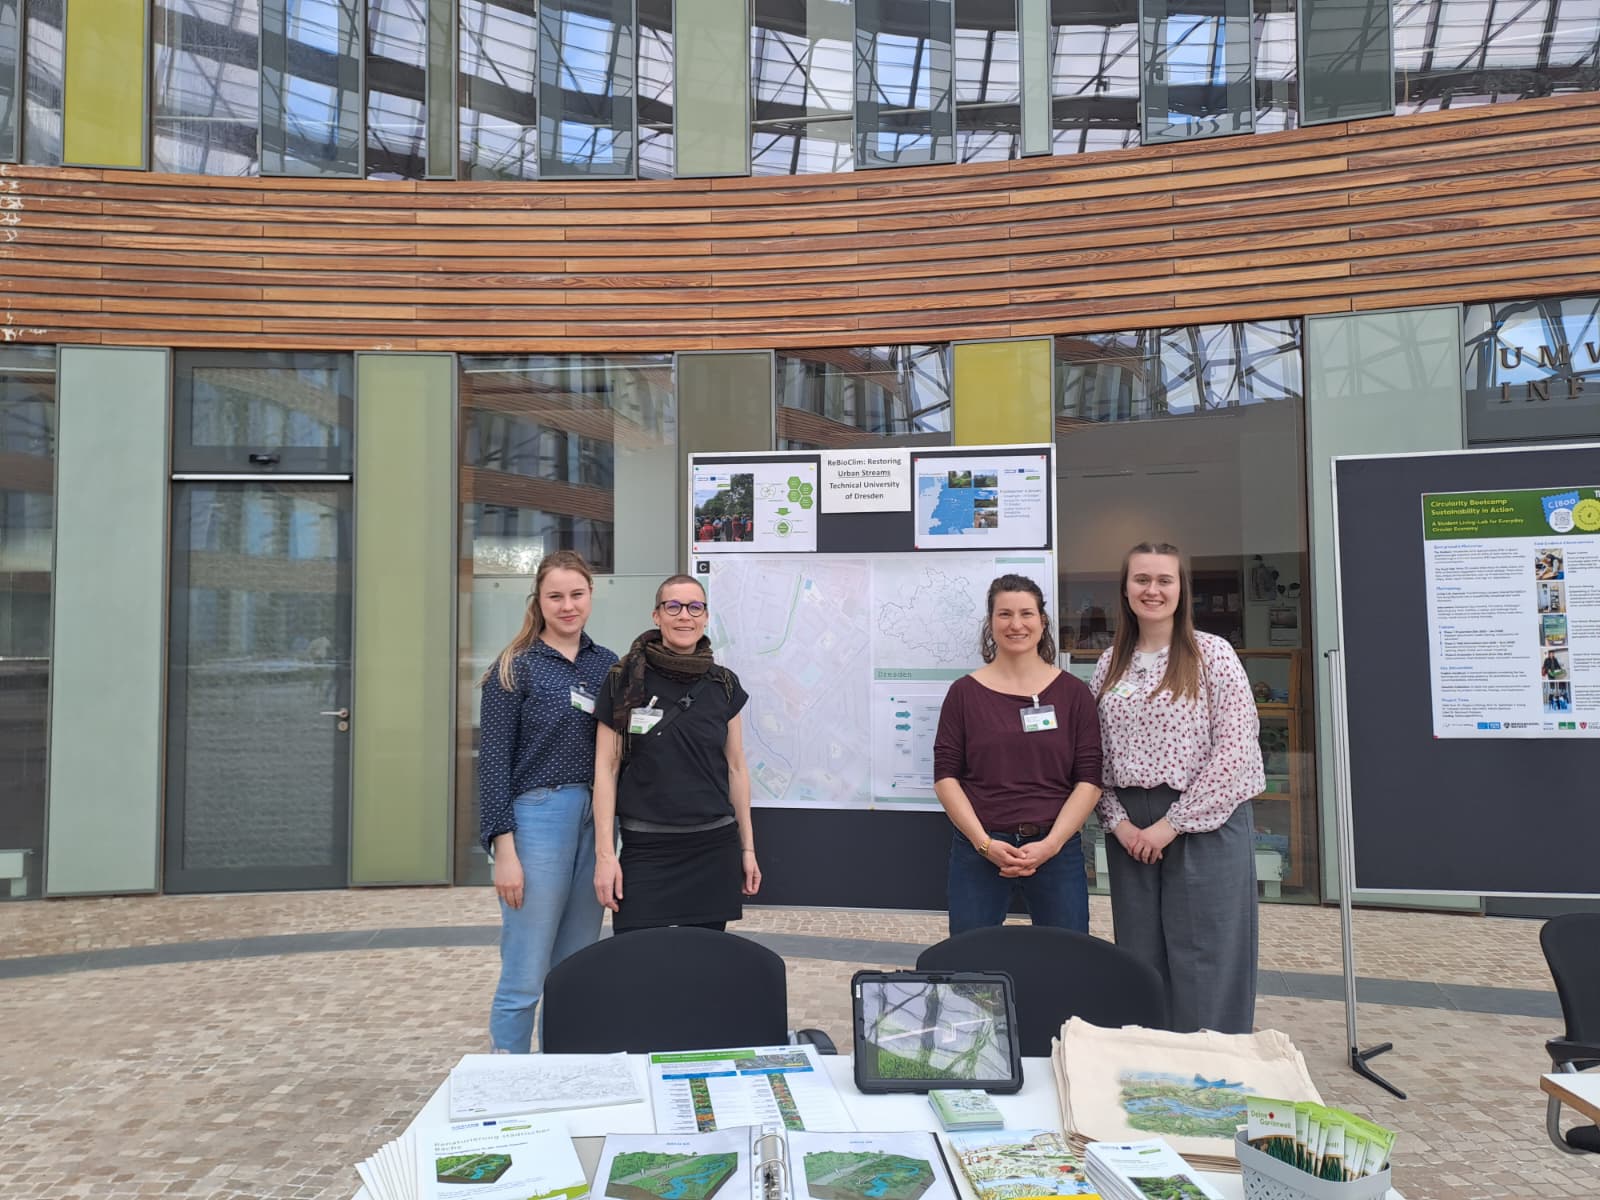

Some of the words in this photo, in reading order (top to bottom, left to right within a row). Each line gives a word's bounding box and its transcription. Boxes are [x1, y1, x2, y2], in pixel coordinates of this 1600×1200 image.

[827, 459, 866, 467] ReBioClim:
[867, 458, 902, 466] Restoring
[863, 481, 900, 489] University
[854, 492, 884, 500] Dresden
[1430, 500, 1468, 508] Circularity
[1469, 498, 1508, 506] Bootcamp
[1431, 508, 1480, 516] Sustainability
[699, 562, 708, 572] C
[878, 671, 912, 679] Dresden
[1250, 1109, 1268, 1120] Deine
